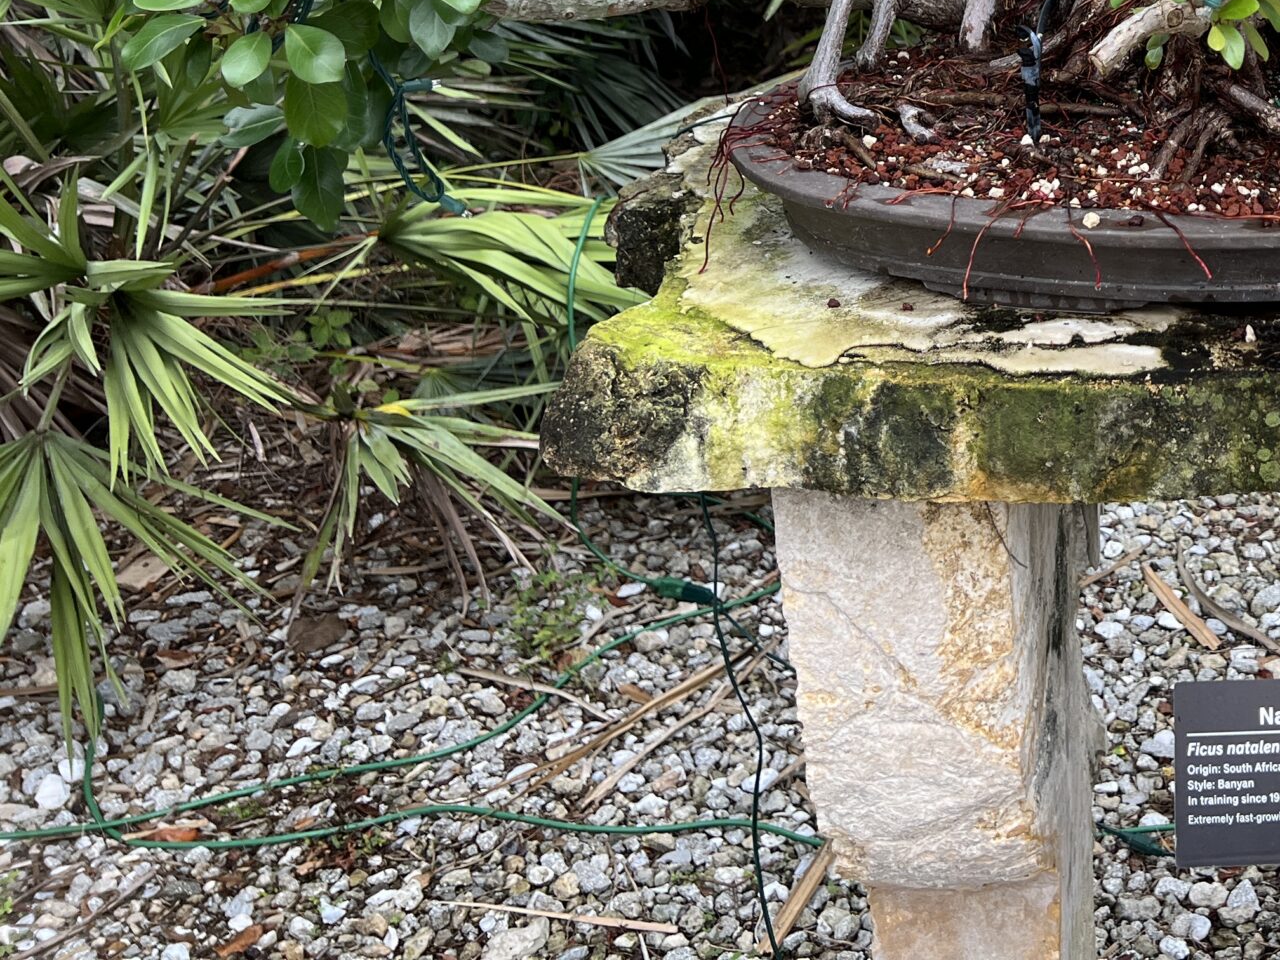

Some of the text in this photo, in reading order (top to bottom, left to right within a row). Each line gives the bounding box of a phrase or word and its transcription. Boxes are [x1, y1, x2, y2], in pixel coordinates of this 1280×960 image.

[1186, 741, 1224, 756] Ficus
[1186, 763, 1221, 777] Origin:
[1222, 762, 1253, 774] South
[1186, 778, 1255, 792] Style: Banyan
[1187, 795, 1198, 806] In
[1199, 793, 1239, 807] training
[1240, 793, 1267, 804] since
[1187, 813, 1234, 825] Extremely
